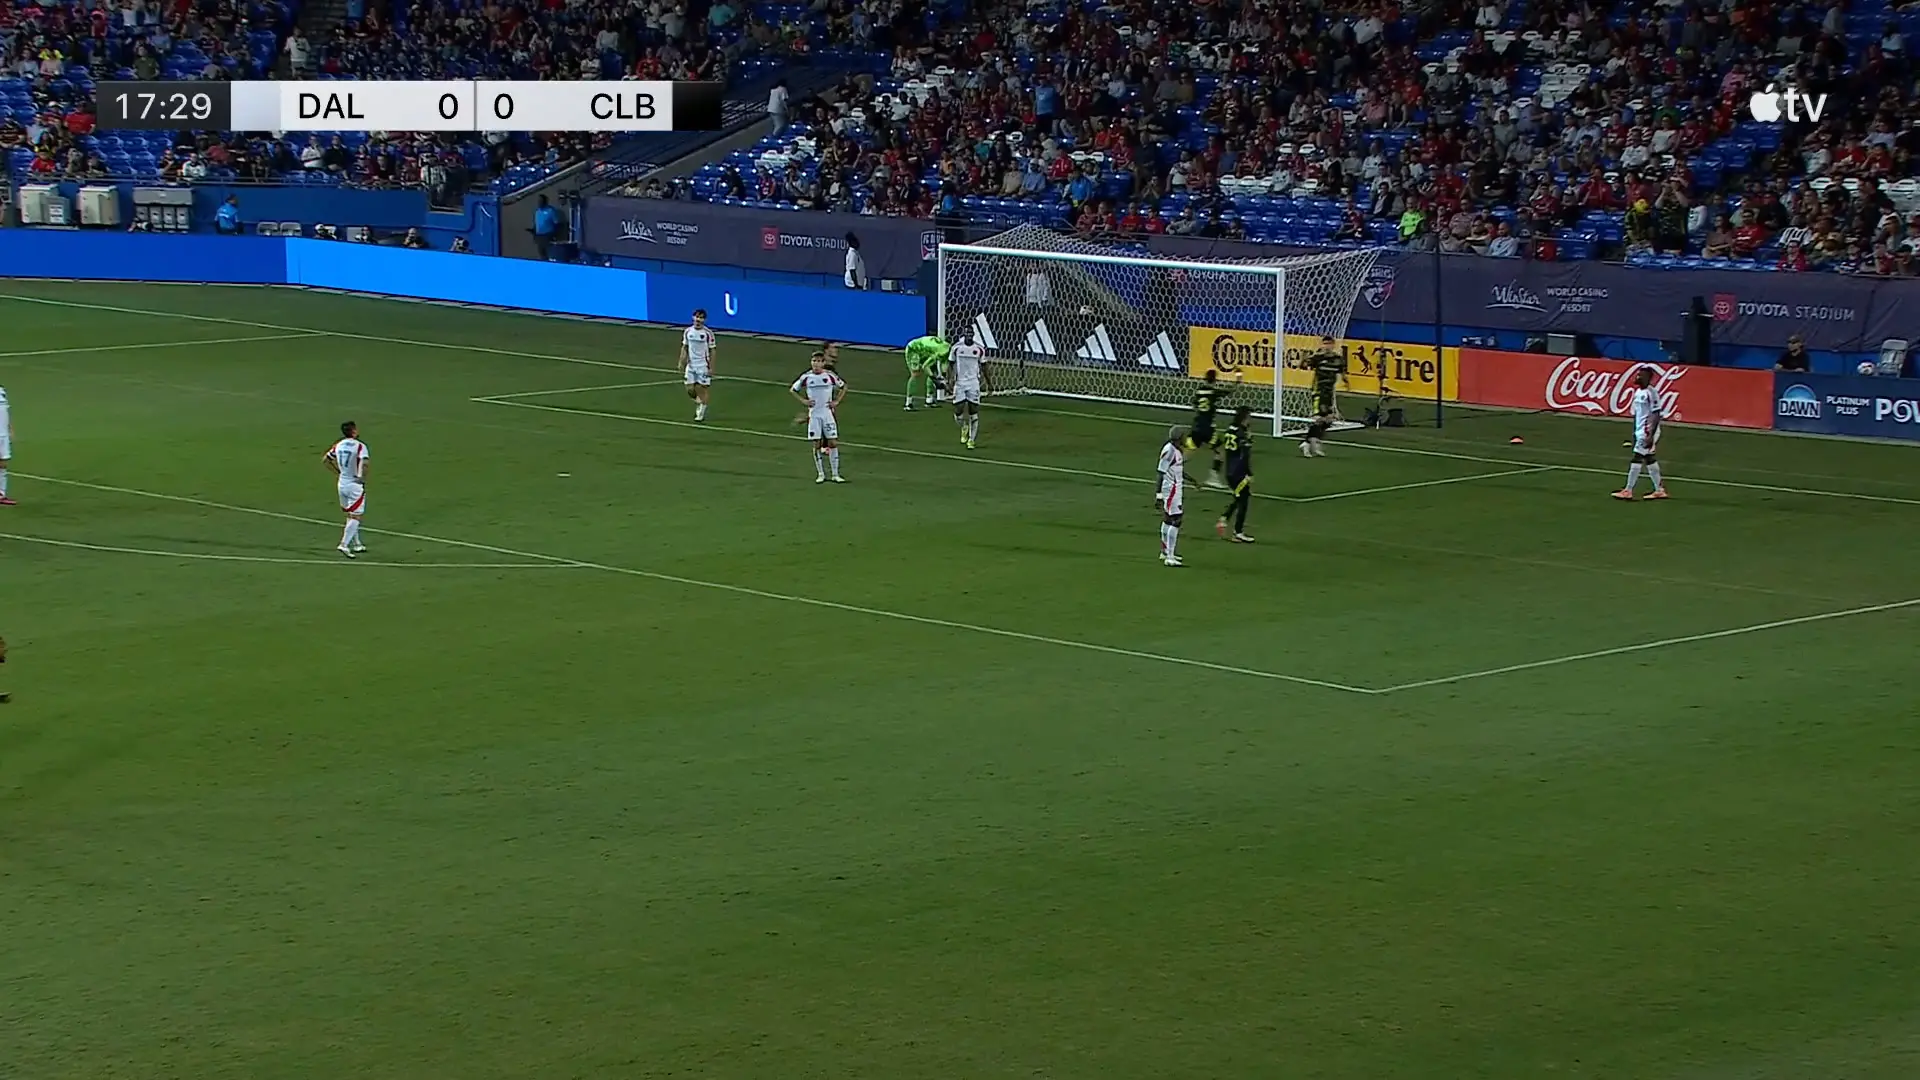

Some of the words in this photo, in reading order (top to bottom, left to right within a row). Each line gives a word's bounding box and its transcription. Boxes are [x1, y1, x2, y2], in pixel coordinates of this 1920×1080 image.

[780, 234, 813, 248] TOYOTA
[815, 237, 850, 250] STADIU
[1546, 287, 1577, 297] WORLD
[1578, 287, 1608, 298] CASINO
[1738, 302, 1790, 318] TOYOTA
[1795, 305, 1855, 321] STADIUM
[1371, 346, 1435, 383] Tire
[1779, 399, 1821, 418] DAWN
[1826, 395, 1870, 407] PLATINUM
[1836, 406, 1859, 415] PLUS
[338, 450, 352, 468] 17
